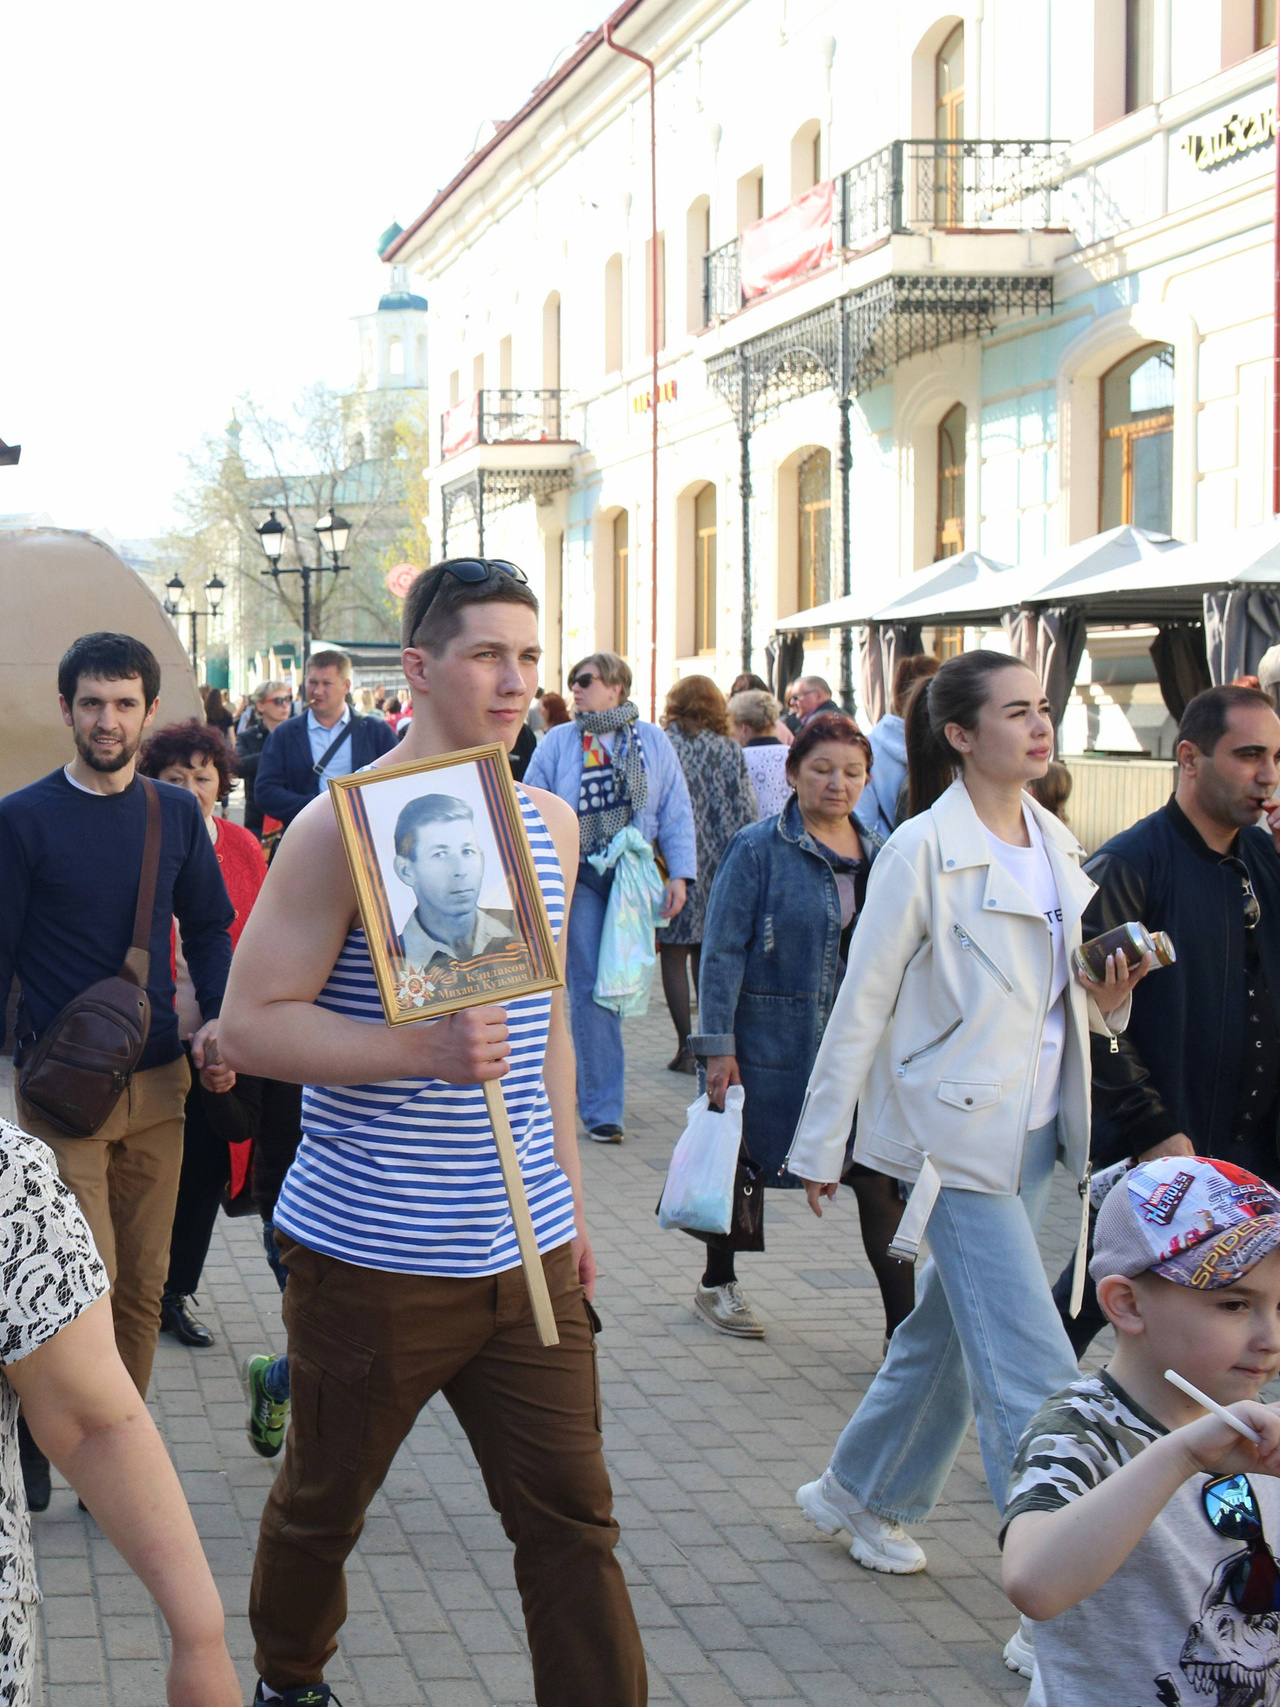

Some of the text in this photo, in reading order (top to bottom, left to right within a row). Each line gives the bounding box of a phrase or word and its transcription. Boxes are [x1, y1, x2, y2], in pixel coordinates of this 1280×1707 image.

[438, 985, 480, 999] Михаил
[482, 973, 528, 991] Кузьмич
[466, 963, 526, 983] Кандаков
[1141, 1174, 1189, 1225] HEROES
[1190, 1216, 1271, 1289] SPIDER
